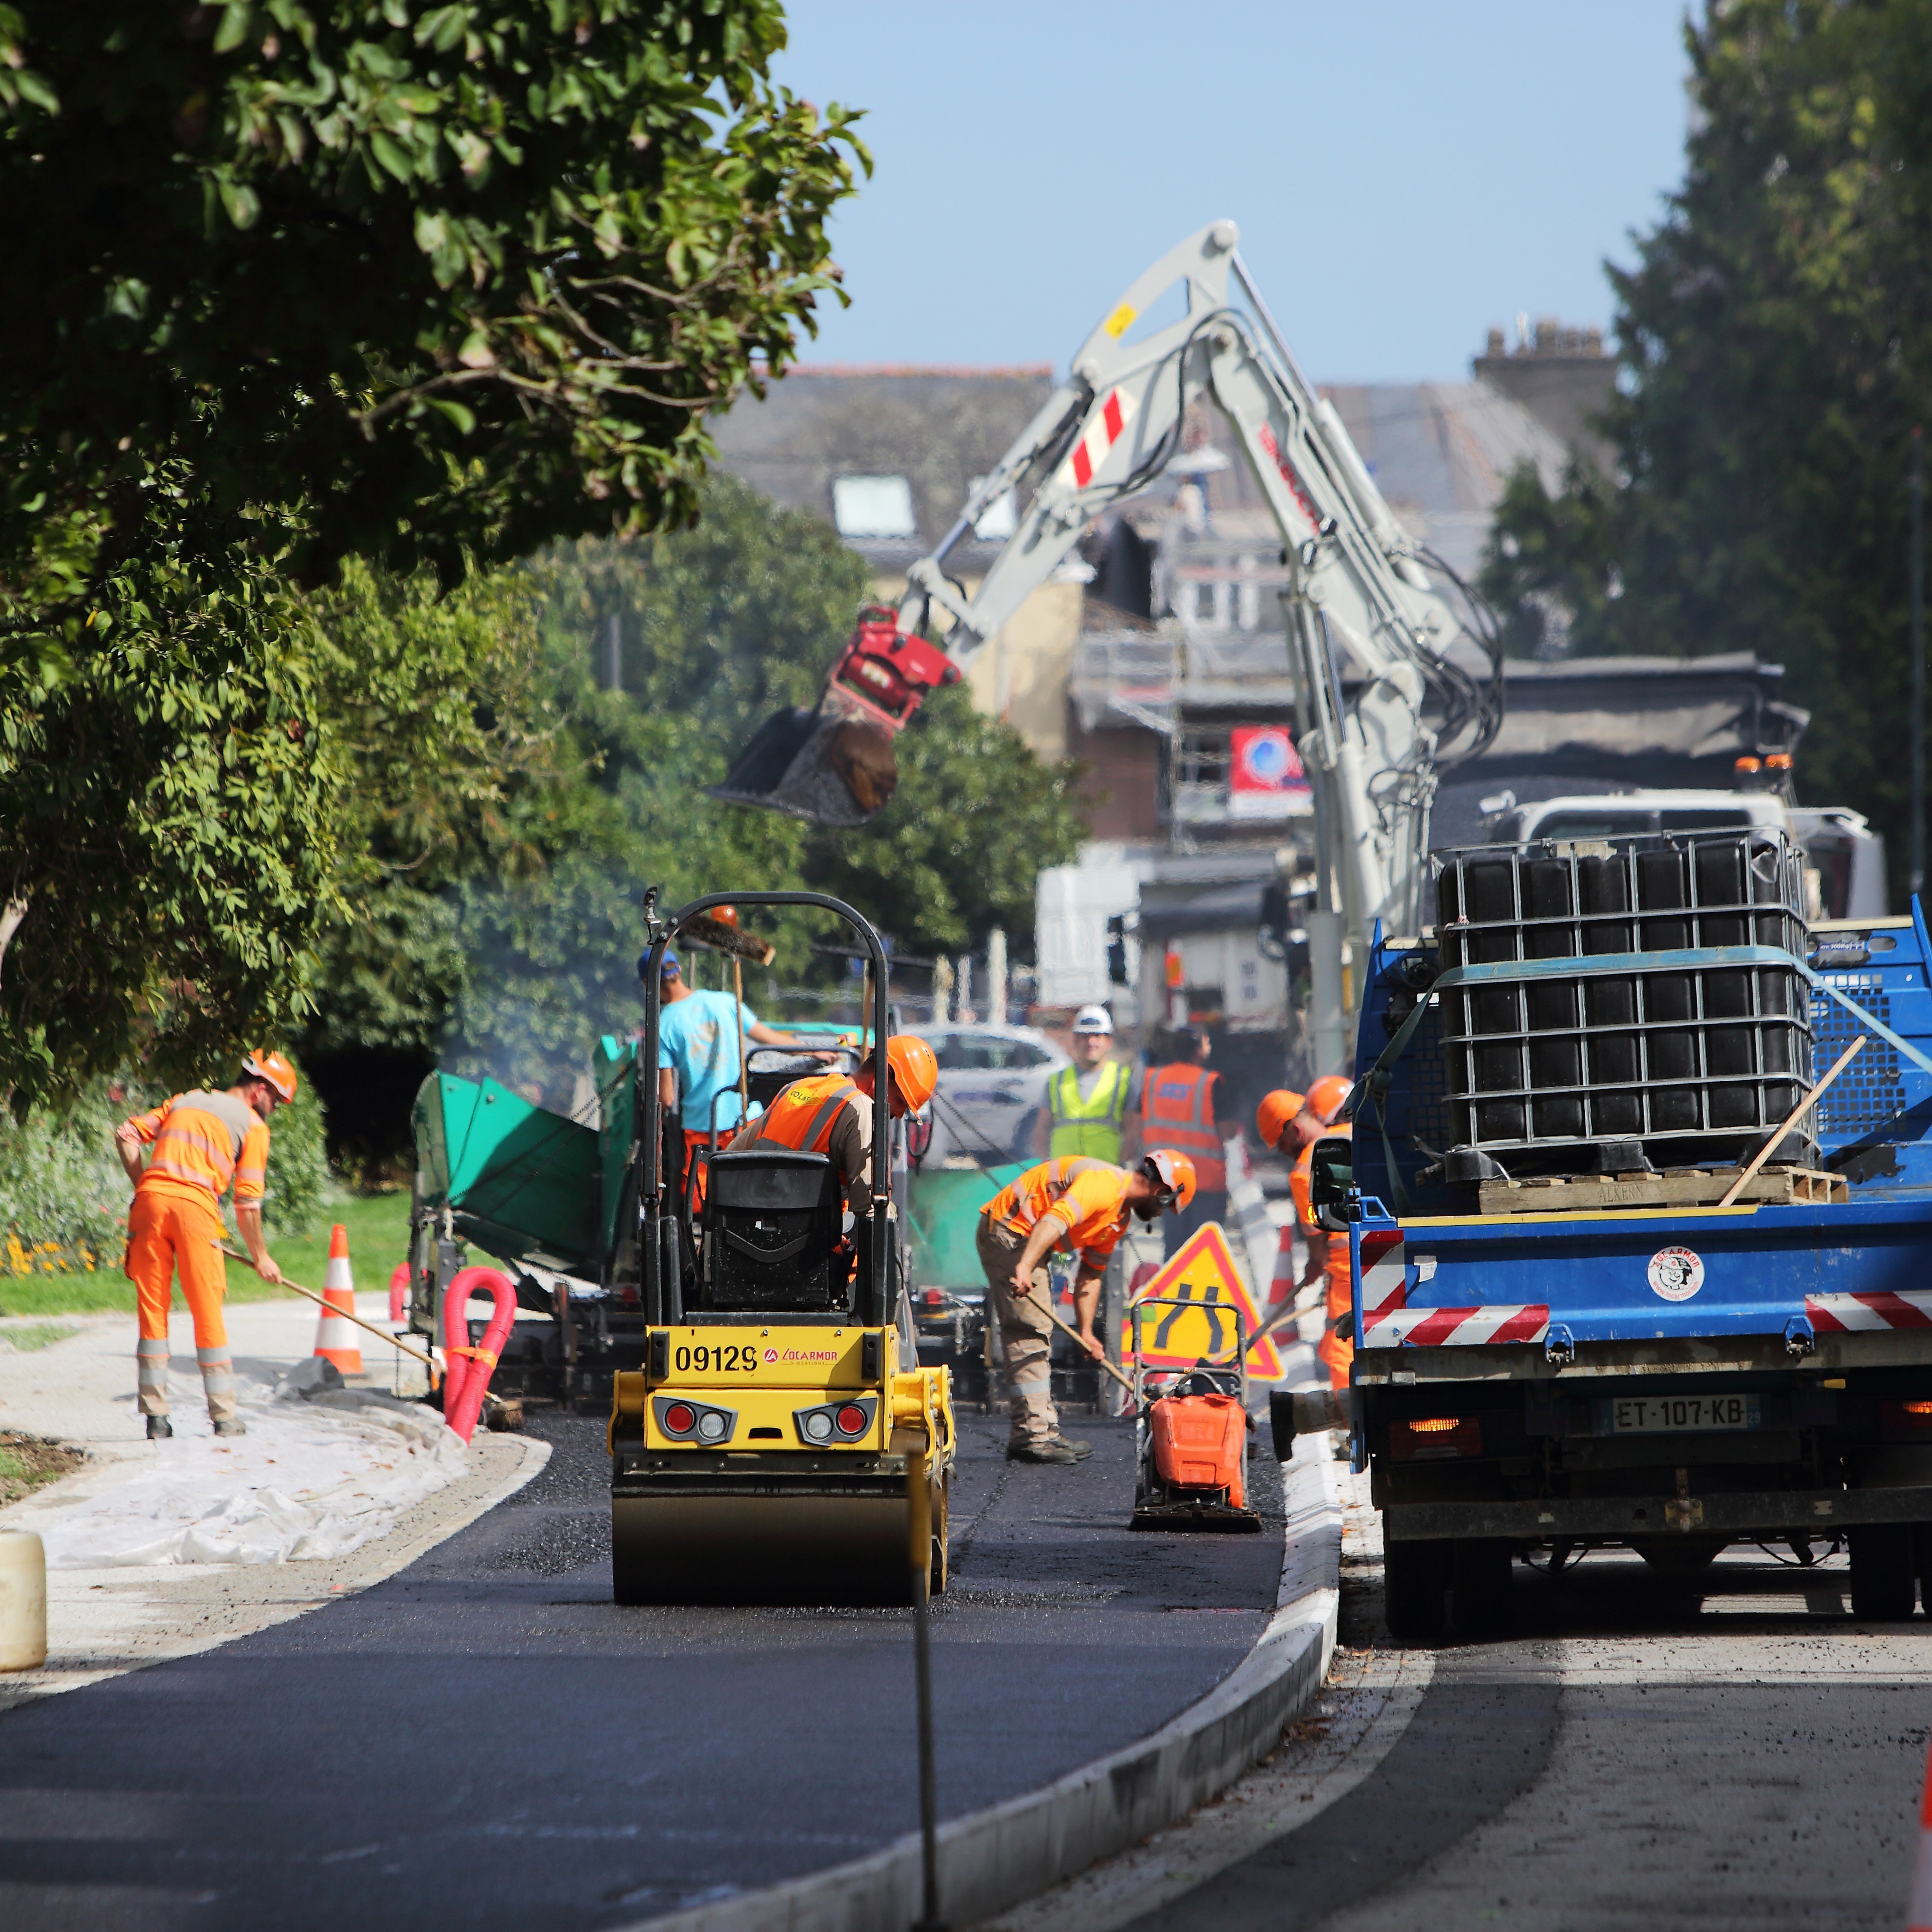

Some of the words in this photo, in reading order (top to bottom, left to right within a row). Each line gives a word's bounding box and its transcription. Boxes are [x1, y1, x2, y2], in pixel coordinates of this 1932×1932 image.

[676, 1346, 757, 1372] 09129
[782, 1348, 837, 1360] LOCARMOR
[1748, 1412, 1760, 1423] 29
